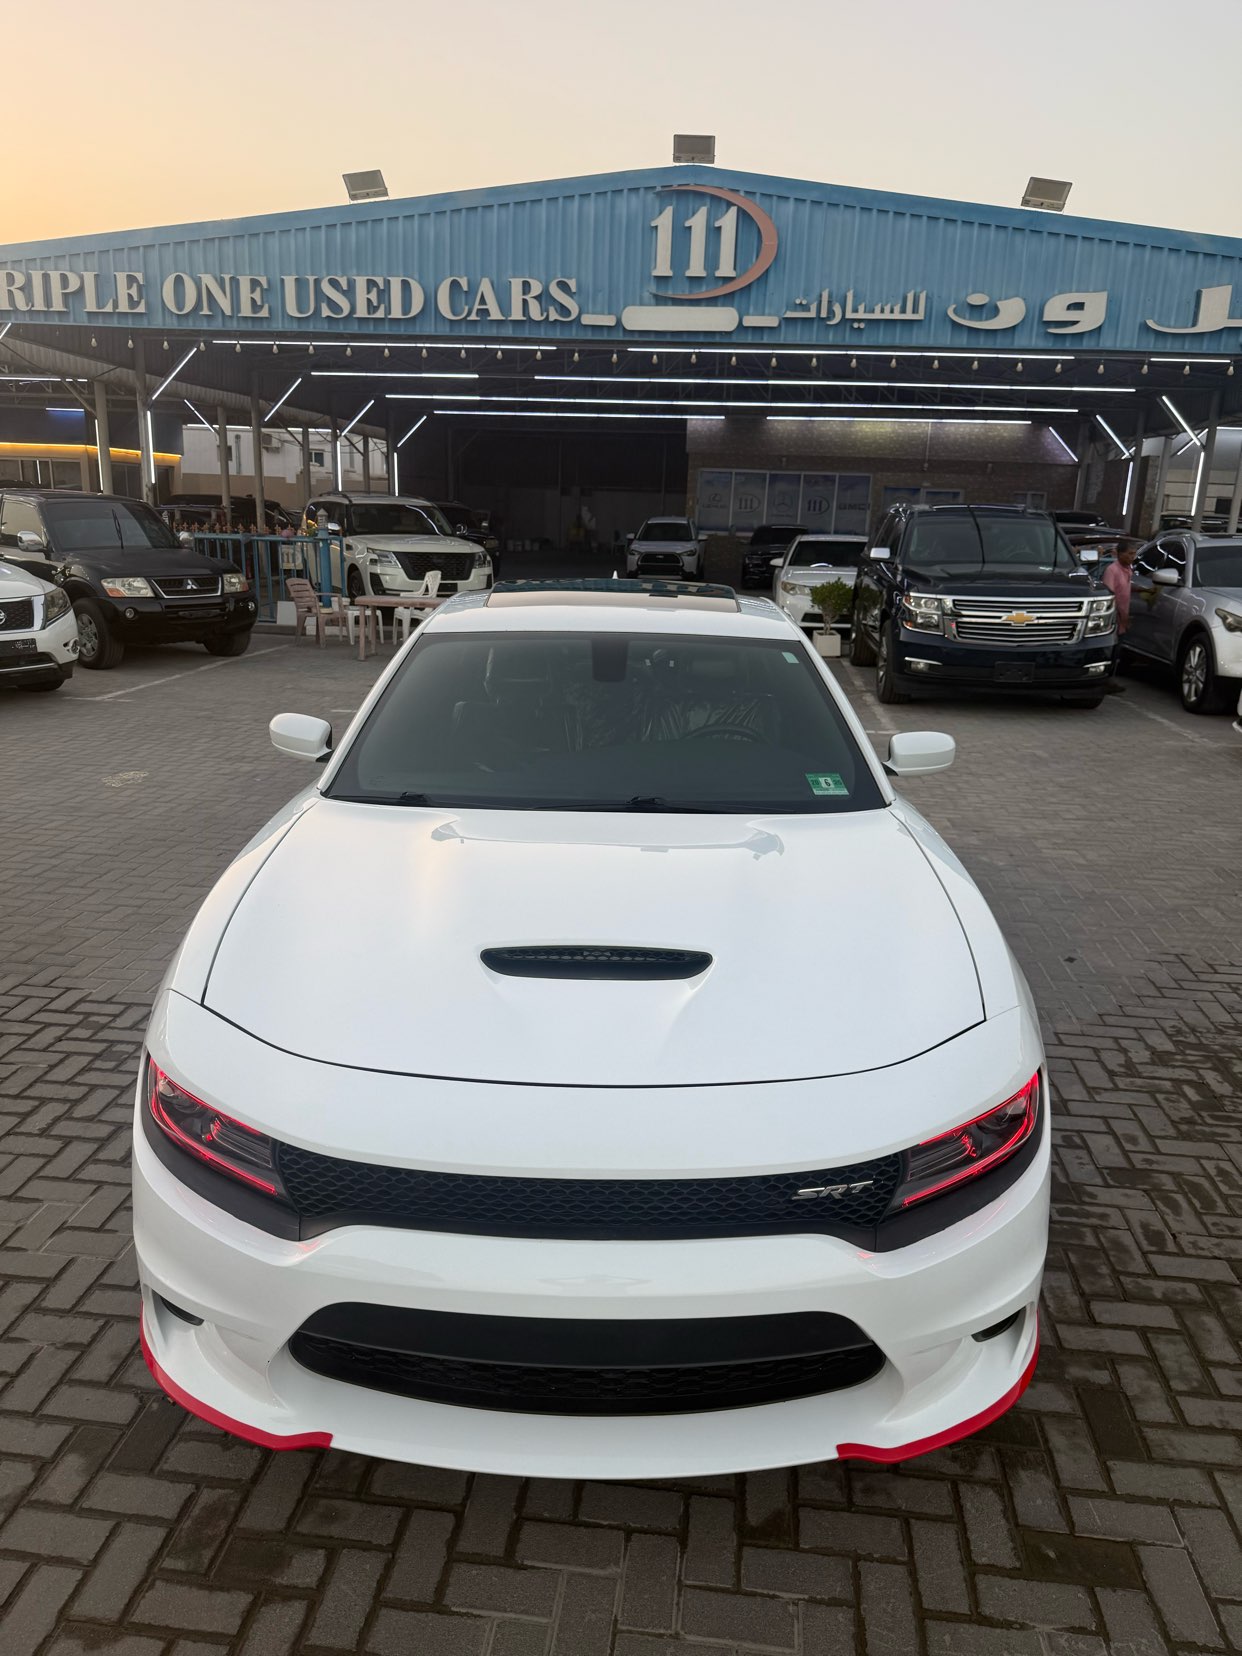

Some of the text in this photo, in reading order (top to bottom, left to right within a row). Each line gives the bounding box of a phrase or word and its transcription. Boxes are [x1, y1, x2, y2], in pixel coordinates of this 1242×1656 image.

[650, 205, 738, 277] 111
[162, 272, 270, 318] ONE
[280, 275, 425, 320] USED
[436, 276, 580, 322] CARS
[782, 288, 927, 330] للسيارات
[791, 1180, 874, 1200] SRT
